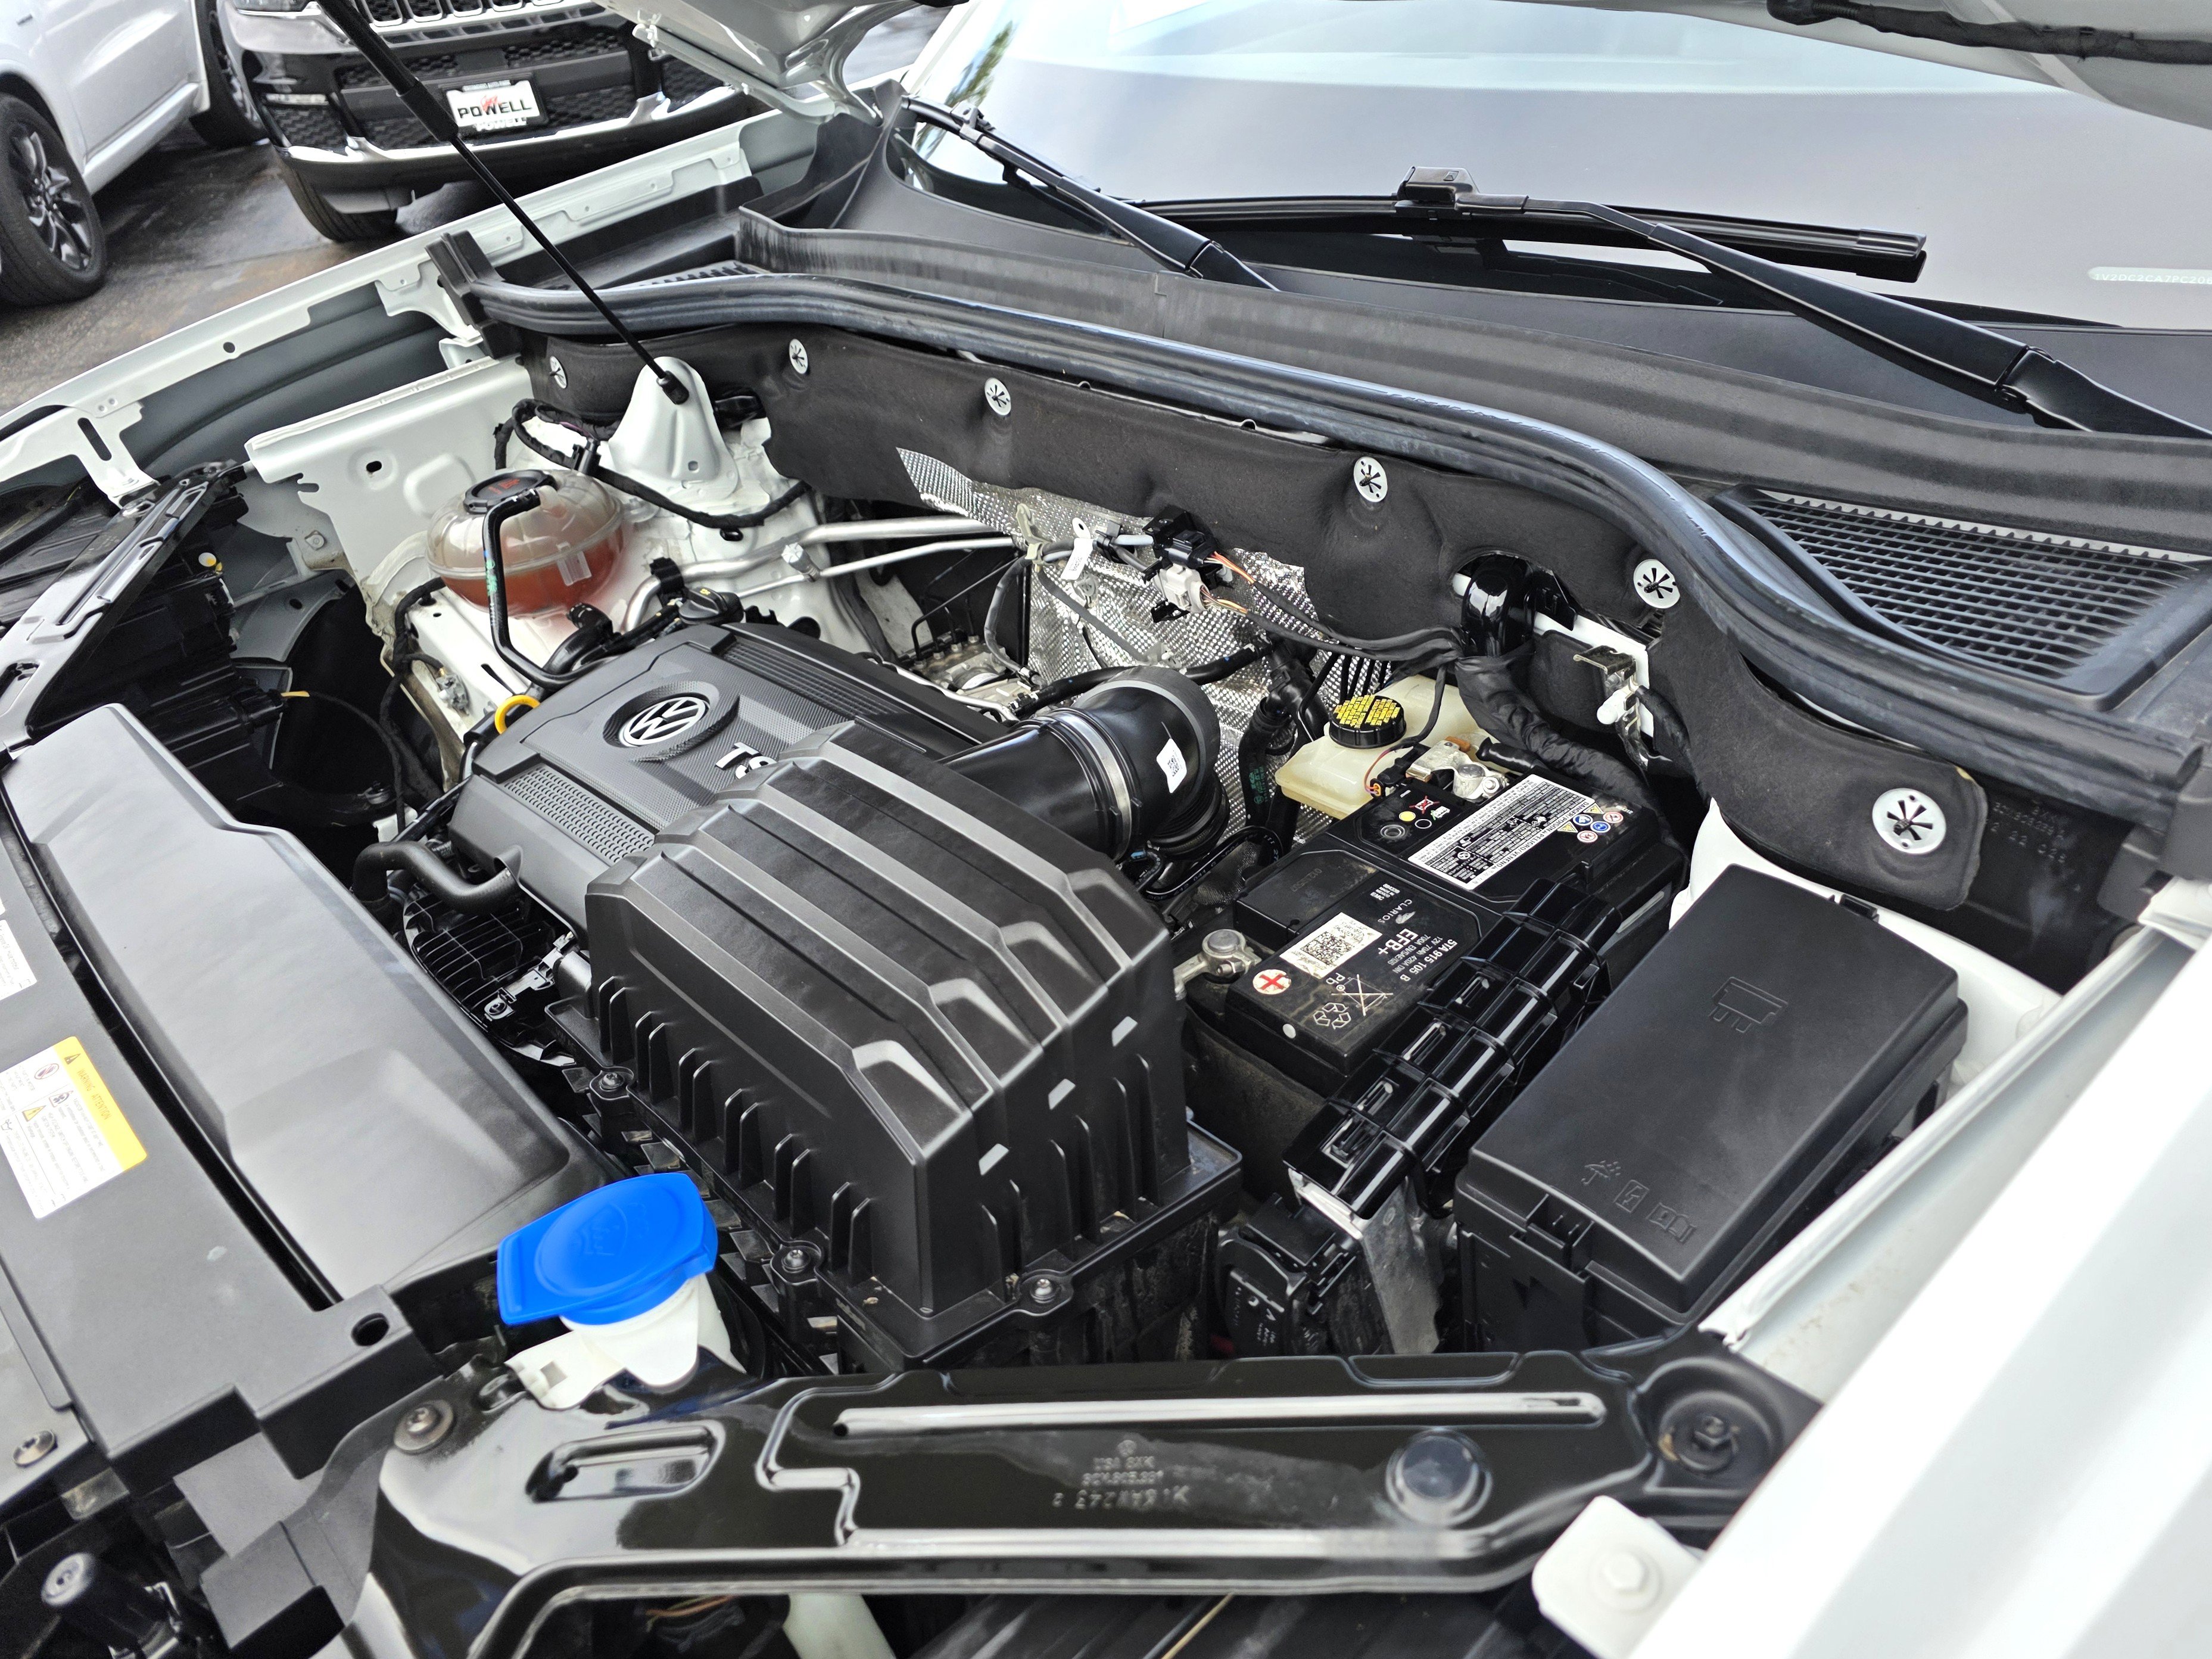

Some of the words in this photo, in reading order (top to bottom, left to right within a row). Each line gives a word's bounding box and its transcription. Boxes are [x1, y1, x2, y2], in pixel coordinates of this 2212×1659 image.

[457, 98, 532, 119] POWELL
[1377, 898, 1413, 924] CLARIOS
[1377, 927, 1419, 955] EFB+
[1414, 933, 1431, 946] 700A
[1429, 935, 1443, 945] 12V
[1437, 938, 1459, 953] 5TA
[1387, 944, 1416, 965] EN/SAE/GS
[1415, 944, 1433, 956] 70Ah
[1422, 949, 1444, 964] 915
[1400, 954, 1419, 967] 420A
[1407, 960, 1428, 975] 105
[1391, 964, 1406, 974] DIN
[1325, 972, 1346, 985] Pb
[1400, 973, 1411, 982] B
[76, 1069, 94, 1091] WARNING
[91, 1092, 112, 1120] ATTENTION
